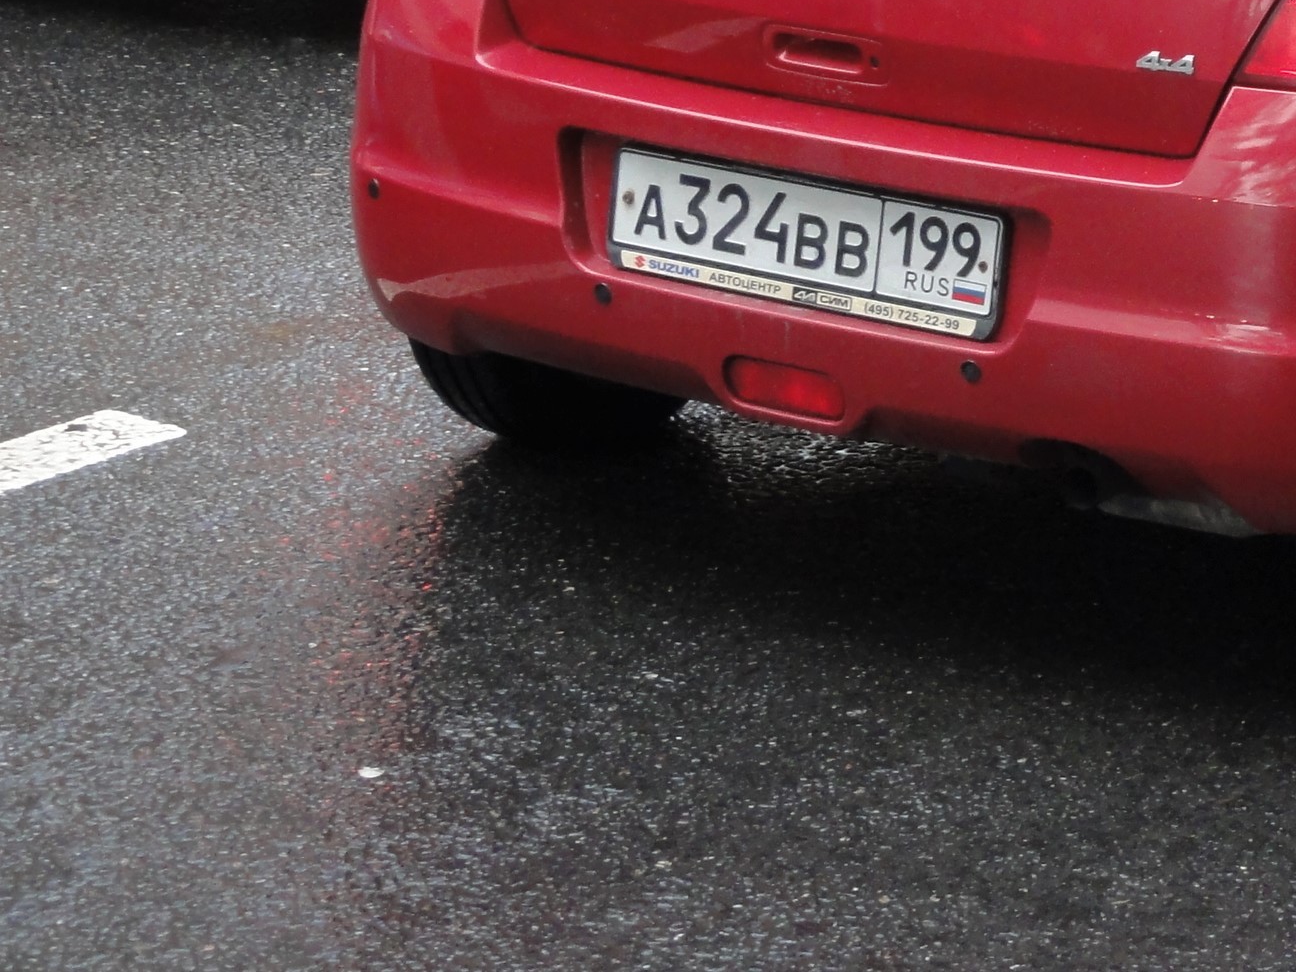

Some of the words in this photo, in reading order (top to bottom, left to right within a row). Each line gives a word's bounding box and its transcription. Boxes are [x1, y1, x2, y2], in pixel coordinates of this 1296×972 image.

[634, 174, 870, 277] А324ВВ
[889, 212, 981, 277] 199
[649, 259, 699, 278] SUZUKI
[709, 272, 781, 294] АВТОЦЕНТР
[864, 302, 893, 318] (495)
[898, 309, 960, 330] 725-22-99
[904, 271, 950, 297] RUS
